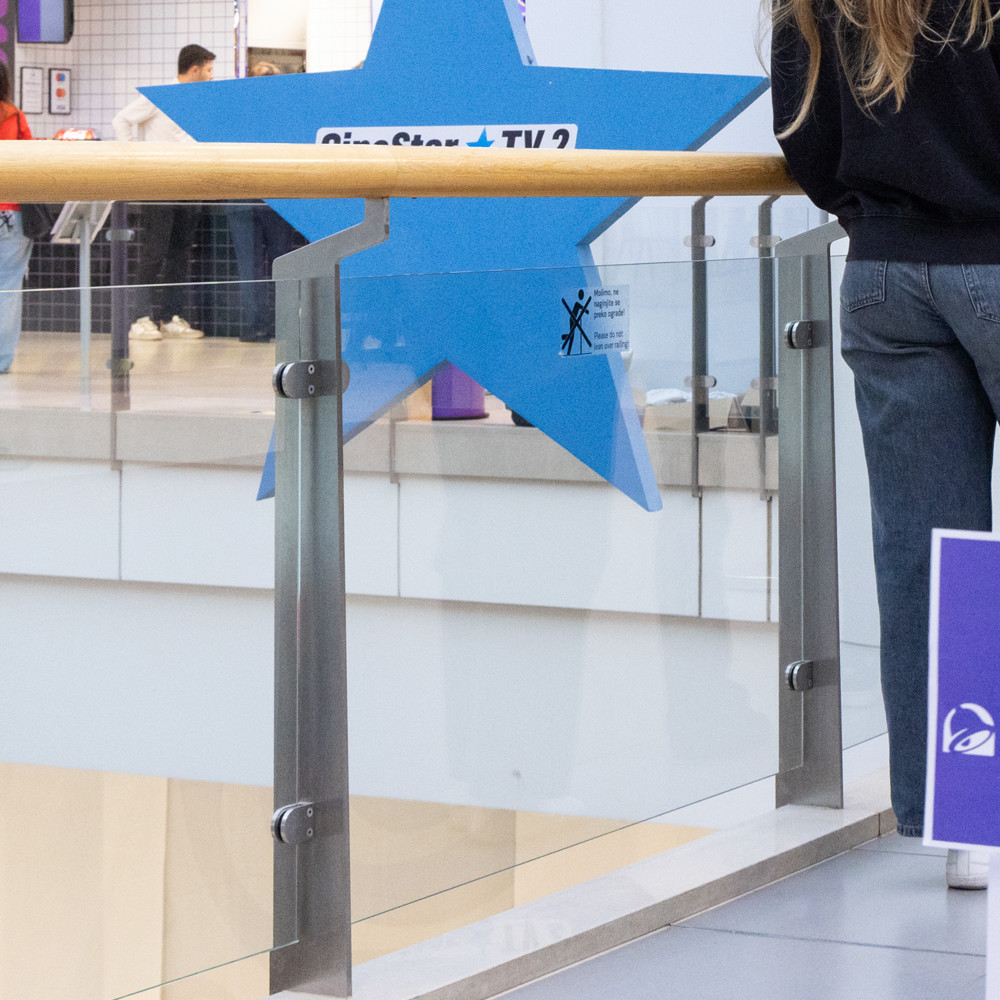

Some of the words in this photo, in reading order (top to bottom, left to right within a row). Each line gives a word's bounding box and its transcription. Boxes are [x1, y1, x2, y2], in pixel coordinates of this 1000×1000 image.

[593, 289, 612, 297] Molimo,
[593, 299, 614, 309] naginjite
[593, 310, 607, 320] preko
[608, 308, 626, 319] ograde!
[593, 331, 608, 340] Please
[616, 330, 624, 338] not
[593, 343, 604, 351] lean
[604, 342, 614, 350] over
